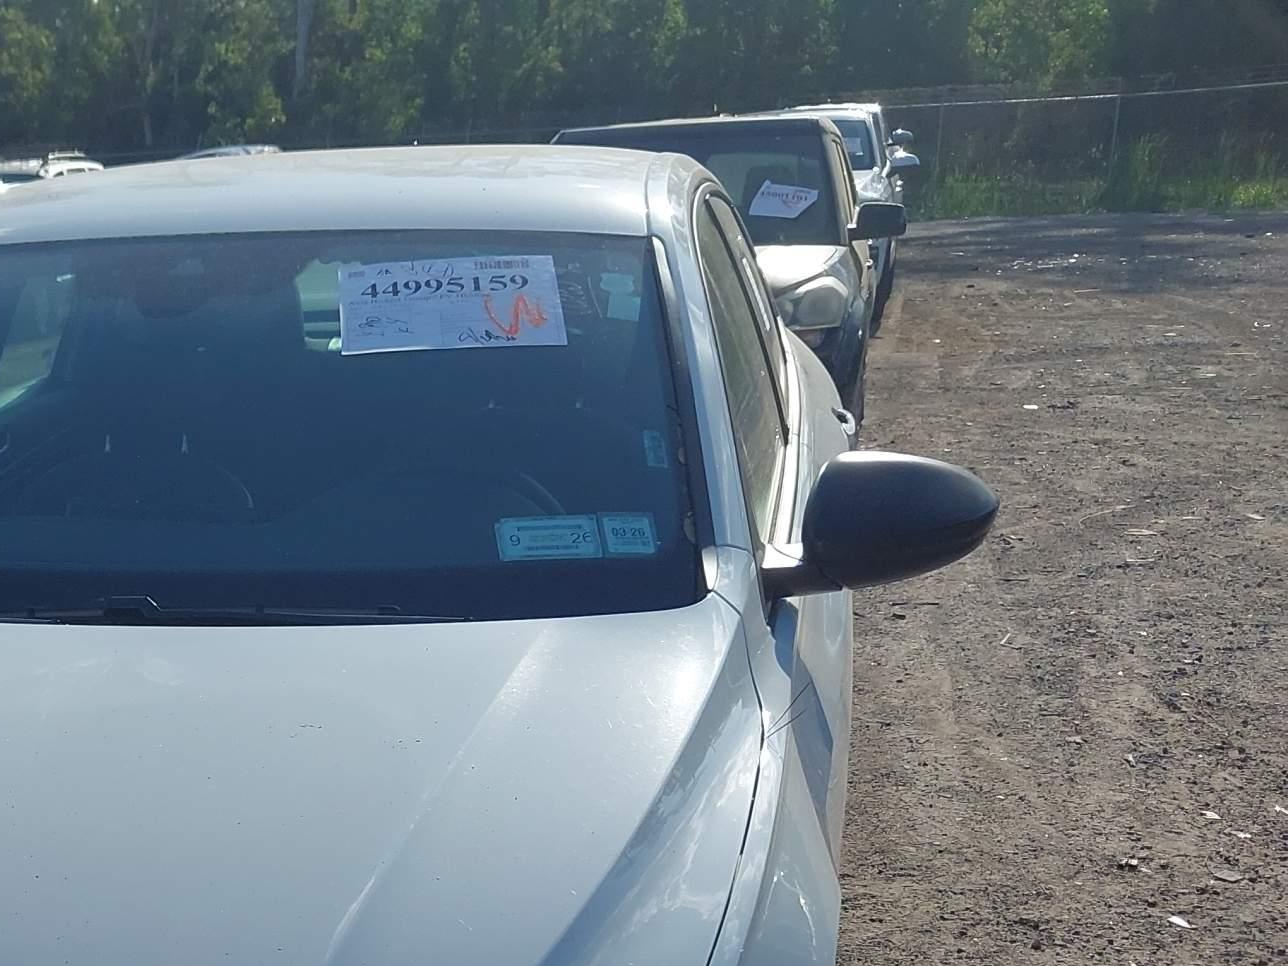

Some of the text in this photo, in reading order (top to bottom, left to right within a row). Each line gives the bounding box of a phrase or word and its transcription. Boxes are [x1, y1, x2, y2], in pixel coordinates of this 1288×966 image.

[360, 274, 529, 299] 44995159
[509, 531, 594, 547] 9 26
